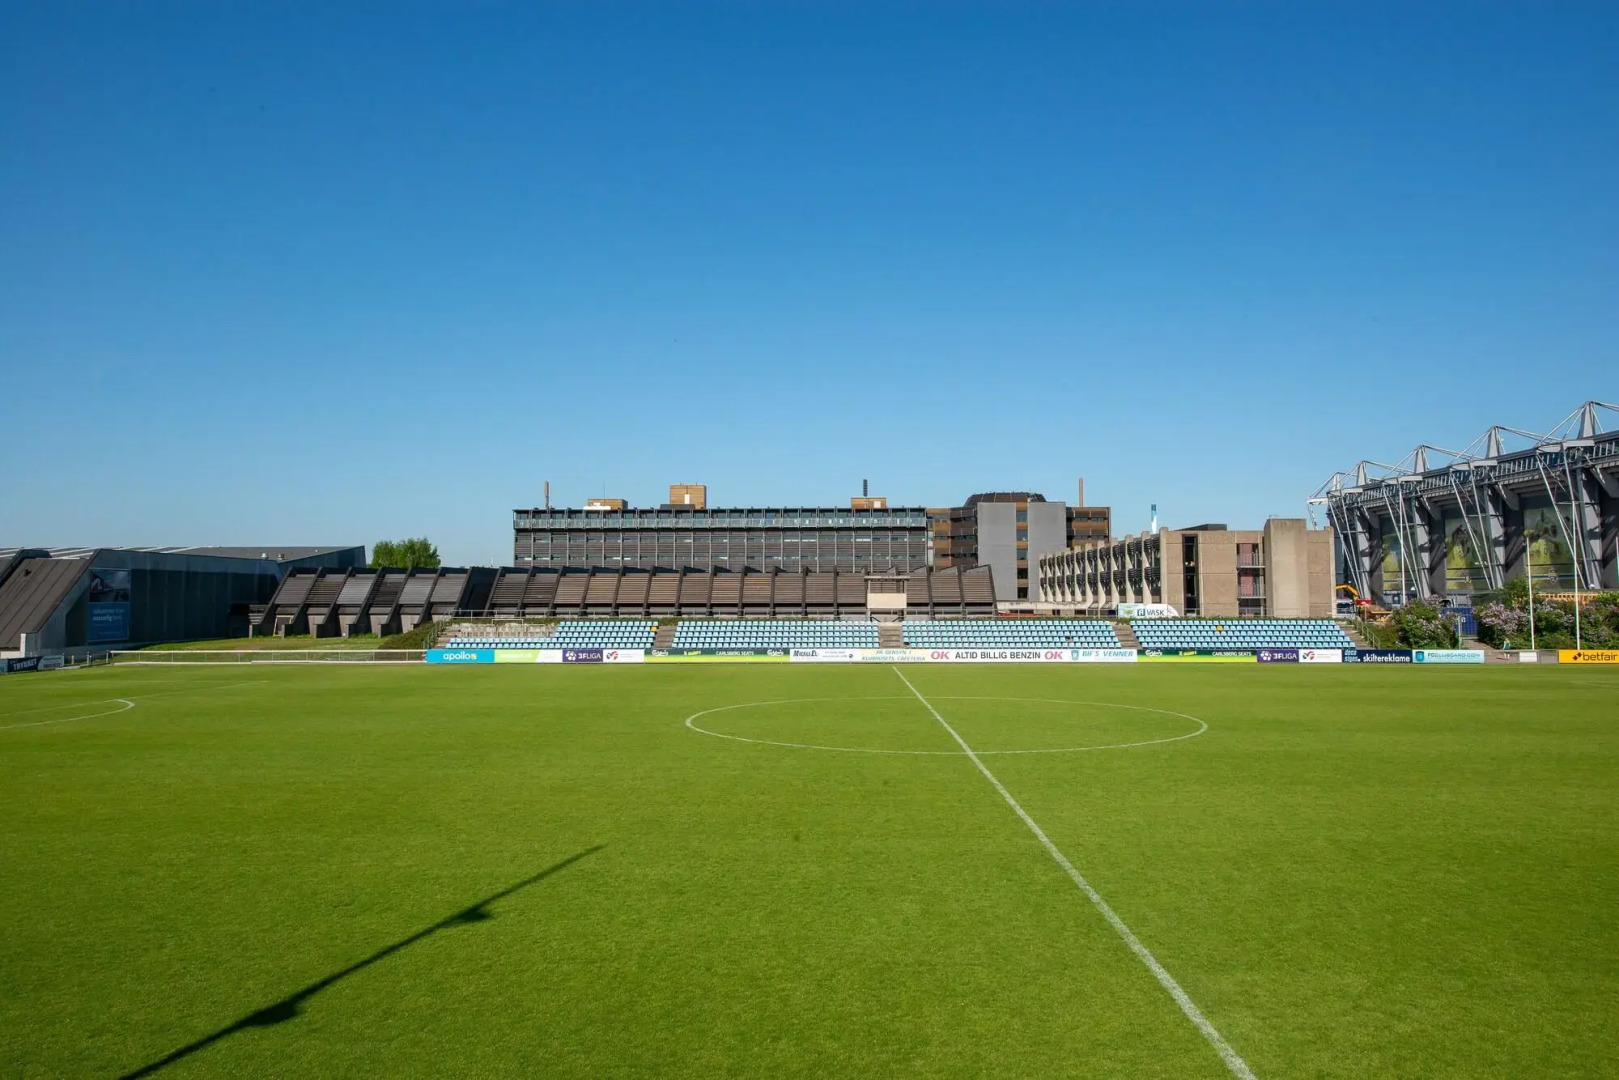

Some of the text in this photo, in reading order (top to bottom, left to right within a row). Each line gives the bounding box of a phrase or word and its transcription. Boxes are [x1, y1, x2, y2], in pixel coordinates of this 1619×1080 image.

[443, 651, 471, 661] apollo
[931, 651, 1063, 660] OK ALTID BILLIG BENZIN OK
[1363, 653, 1411, 662] skiltereklame
[1582, 651, 1618, 661] betfair
